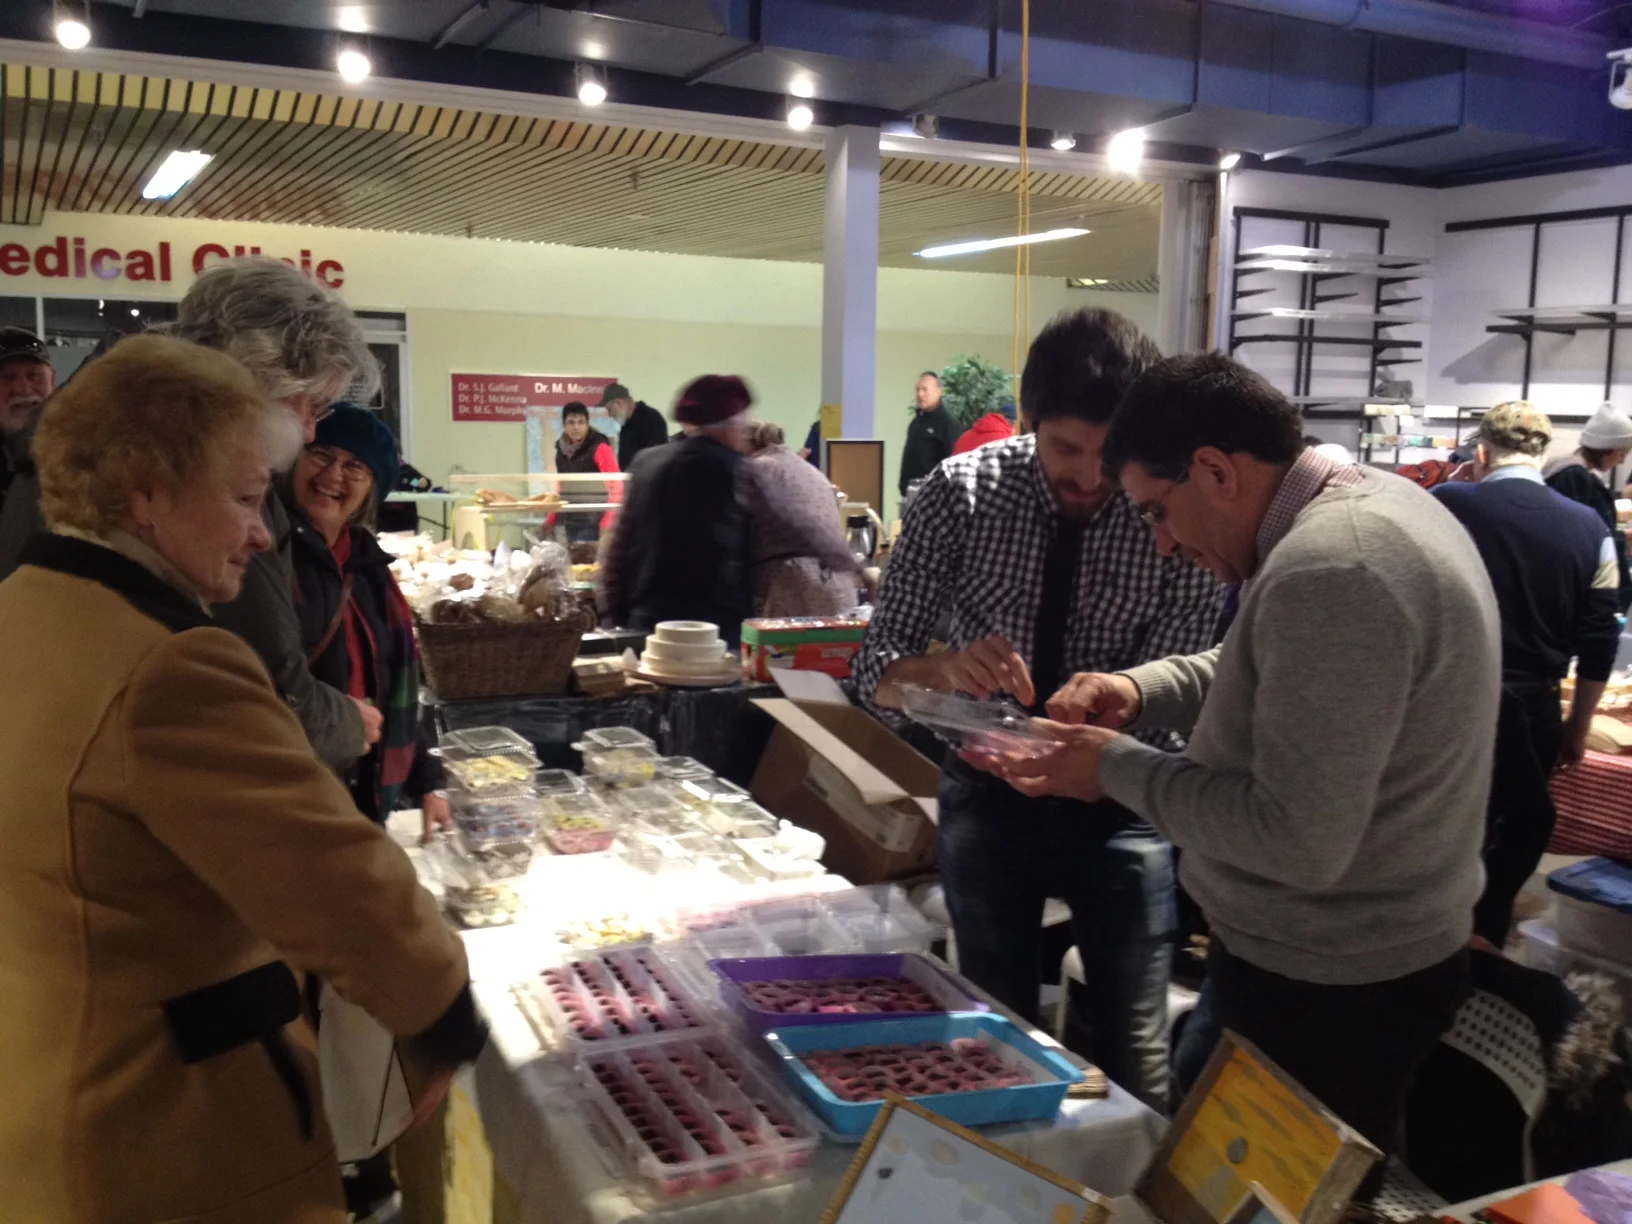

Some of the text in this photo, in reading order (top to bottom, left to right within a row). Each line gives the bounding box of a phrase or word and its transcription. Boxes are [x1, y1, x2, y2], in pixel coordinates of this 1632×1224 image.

[458, 382, 470, 392] Dr.
[534, 382, 549, 394] Dr.
[552, 383, 565, 394] M.
[458, 394, 470, 403] Dr.
[459, 405, 471, 415] Dr.
